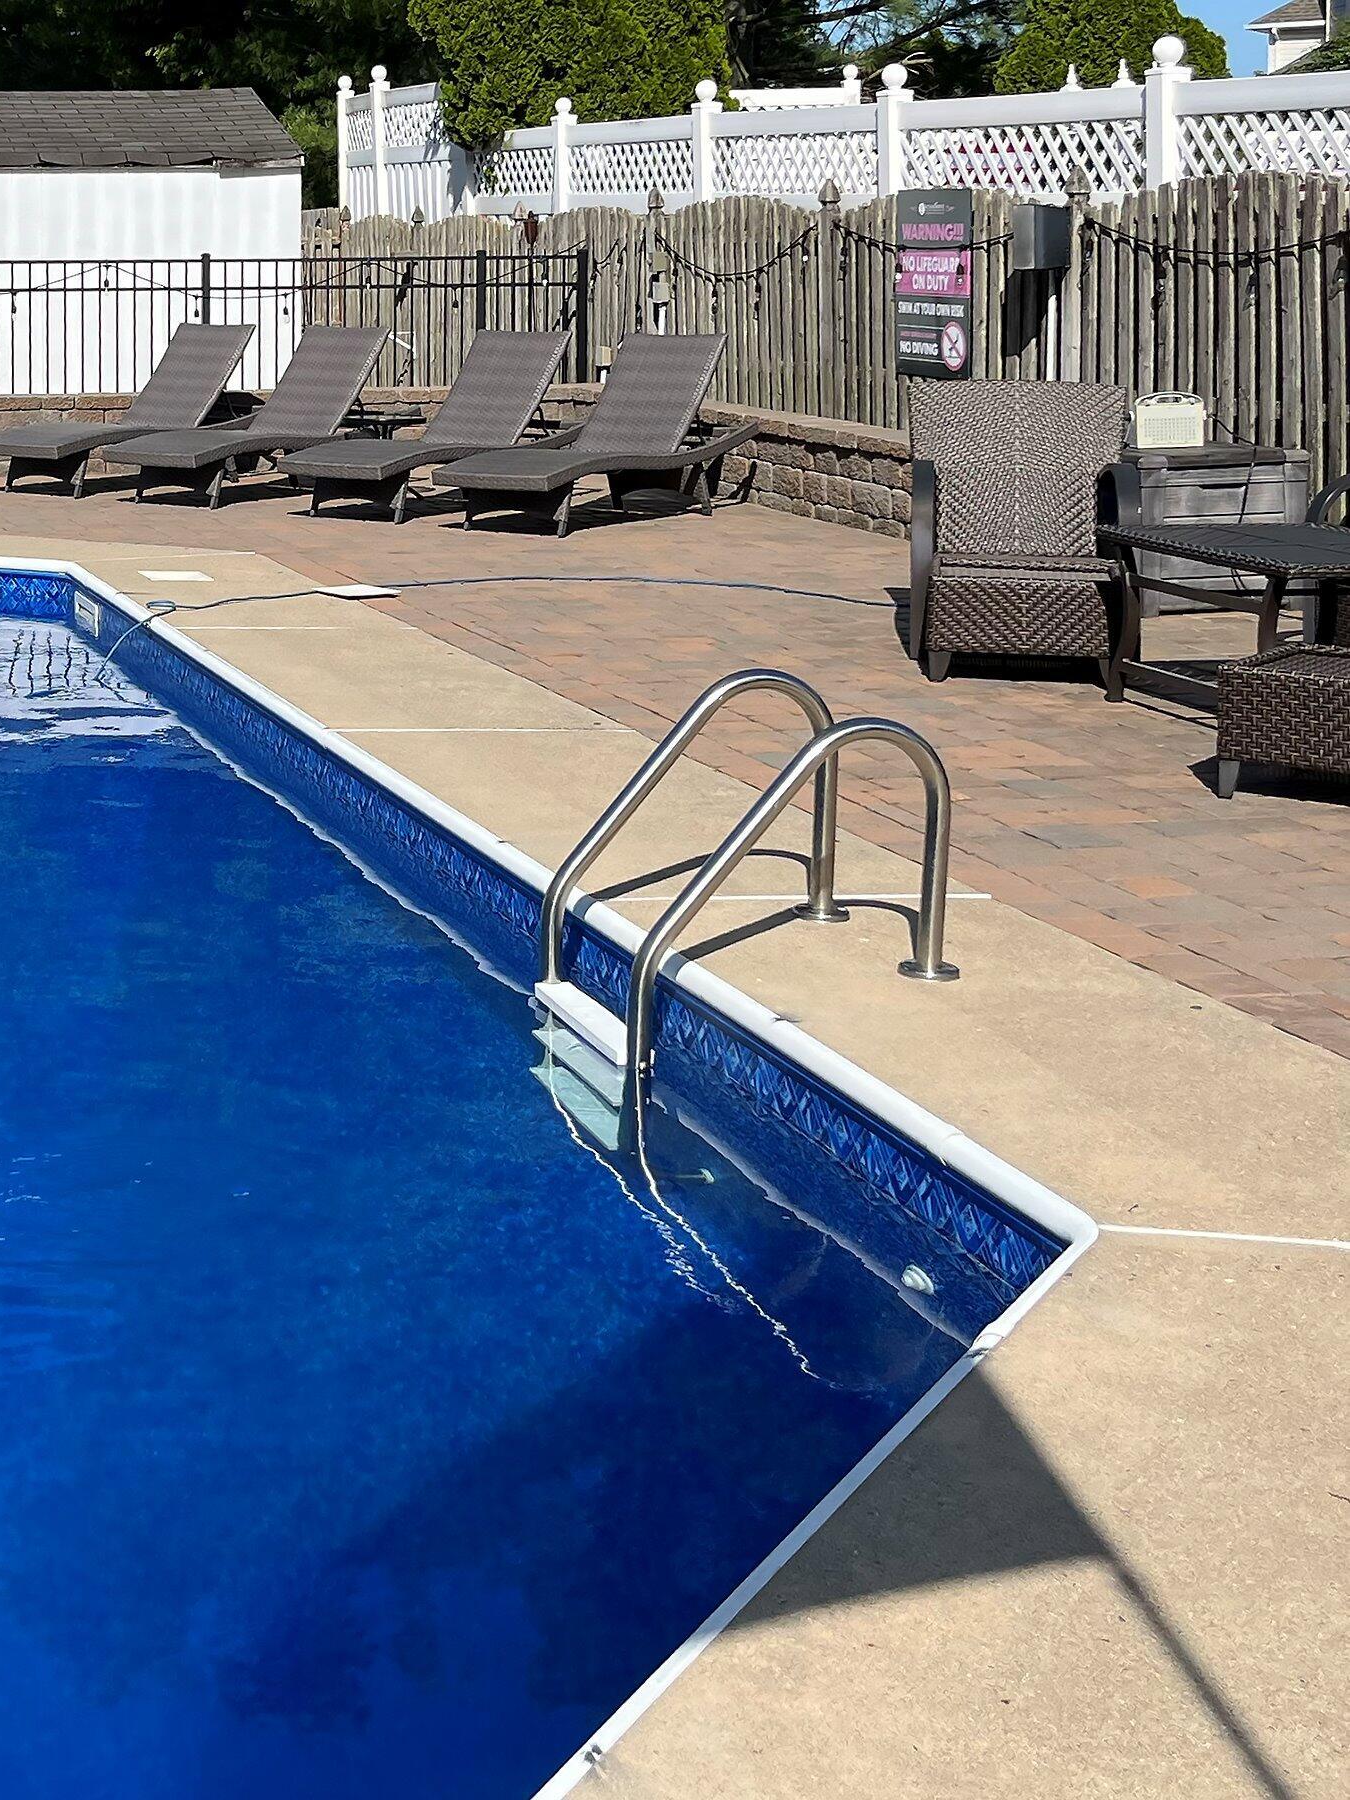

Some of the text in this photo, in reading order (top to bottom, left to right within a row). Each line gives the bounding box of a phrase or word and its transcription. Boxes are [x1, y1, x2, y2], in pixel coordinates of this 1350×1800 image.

[902, 223, 964, 241] WARNING!!!
[902, 256, 915, 271] NO
[912, 273, 950, 291] ON DUTY
[899, 340, 939, 356] NO DIVING
